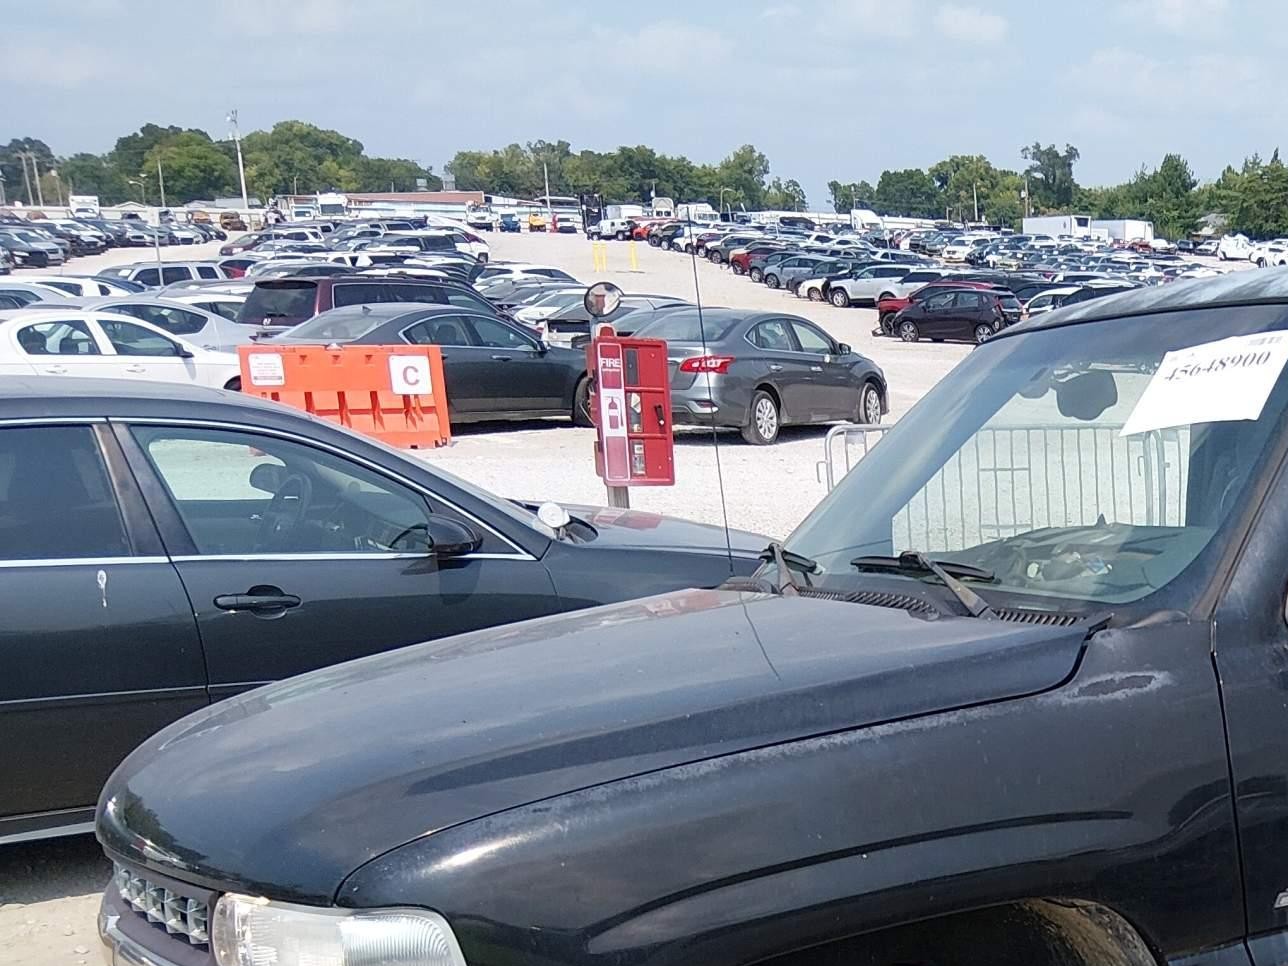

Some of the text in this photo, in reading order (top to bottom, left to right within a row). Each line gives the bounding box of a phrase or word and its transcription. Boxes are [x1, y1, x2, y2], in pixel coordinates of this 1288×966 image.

[600, 357, 621, 368] FIRE
[1164, 350, 1272, 381] 45648900
[402, 365, 420, 386] C
